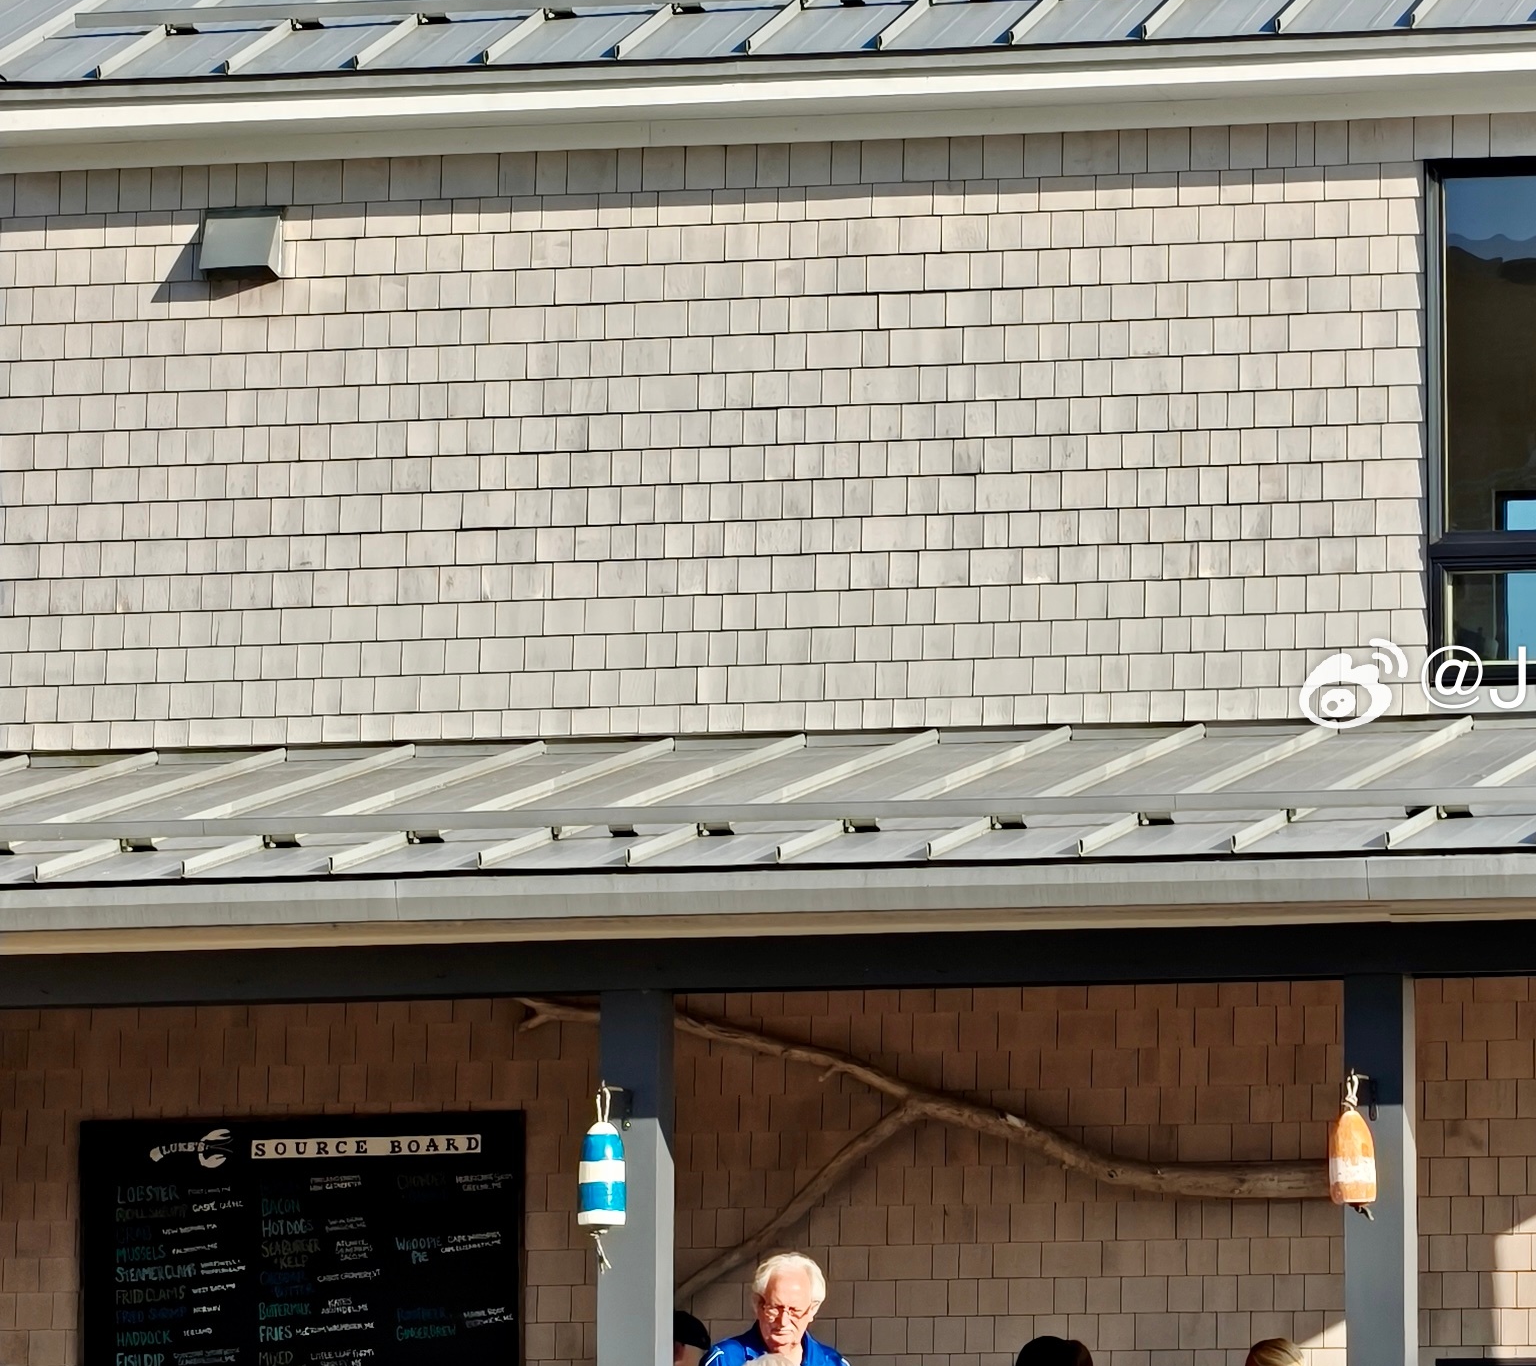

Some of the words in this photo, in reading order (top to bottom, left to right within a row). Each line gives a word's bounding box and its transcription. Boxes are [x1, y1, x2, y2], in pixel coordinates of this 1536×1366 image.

[162, 1141, 206, 1155] LUKE'S
[254, 1139, 368, 1157] SOURCE
[389, 1136, 480, 1155] BOARD
[116, 1184, 180, 1204] LOBSTER
[261, 1197, 301, 1217] BACON
[115, 1244, 166, 1263] MUSSELS
[115, 1329, 173, 1347] HADDOCK
[259, 1325, 293, 1343] FRIES
